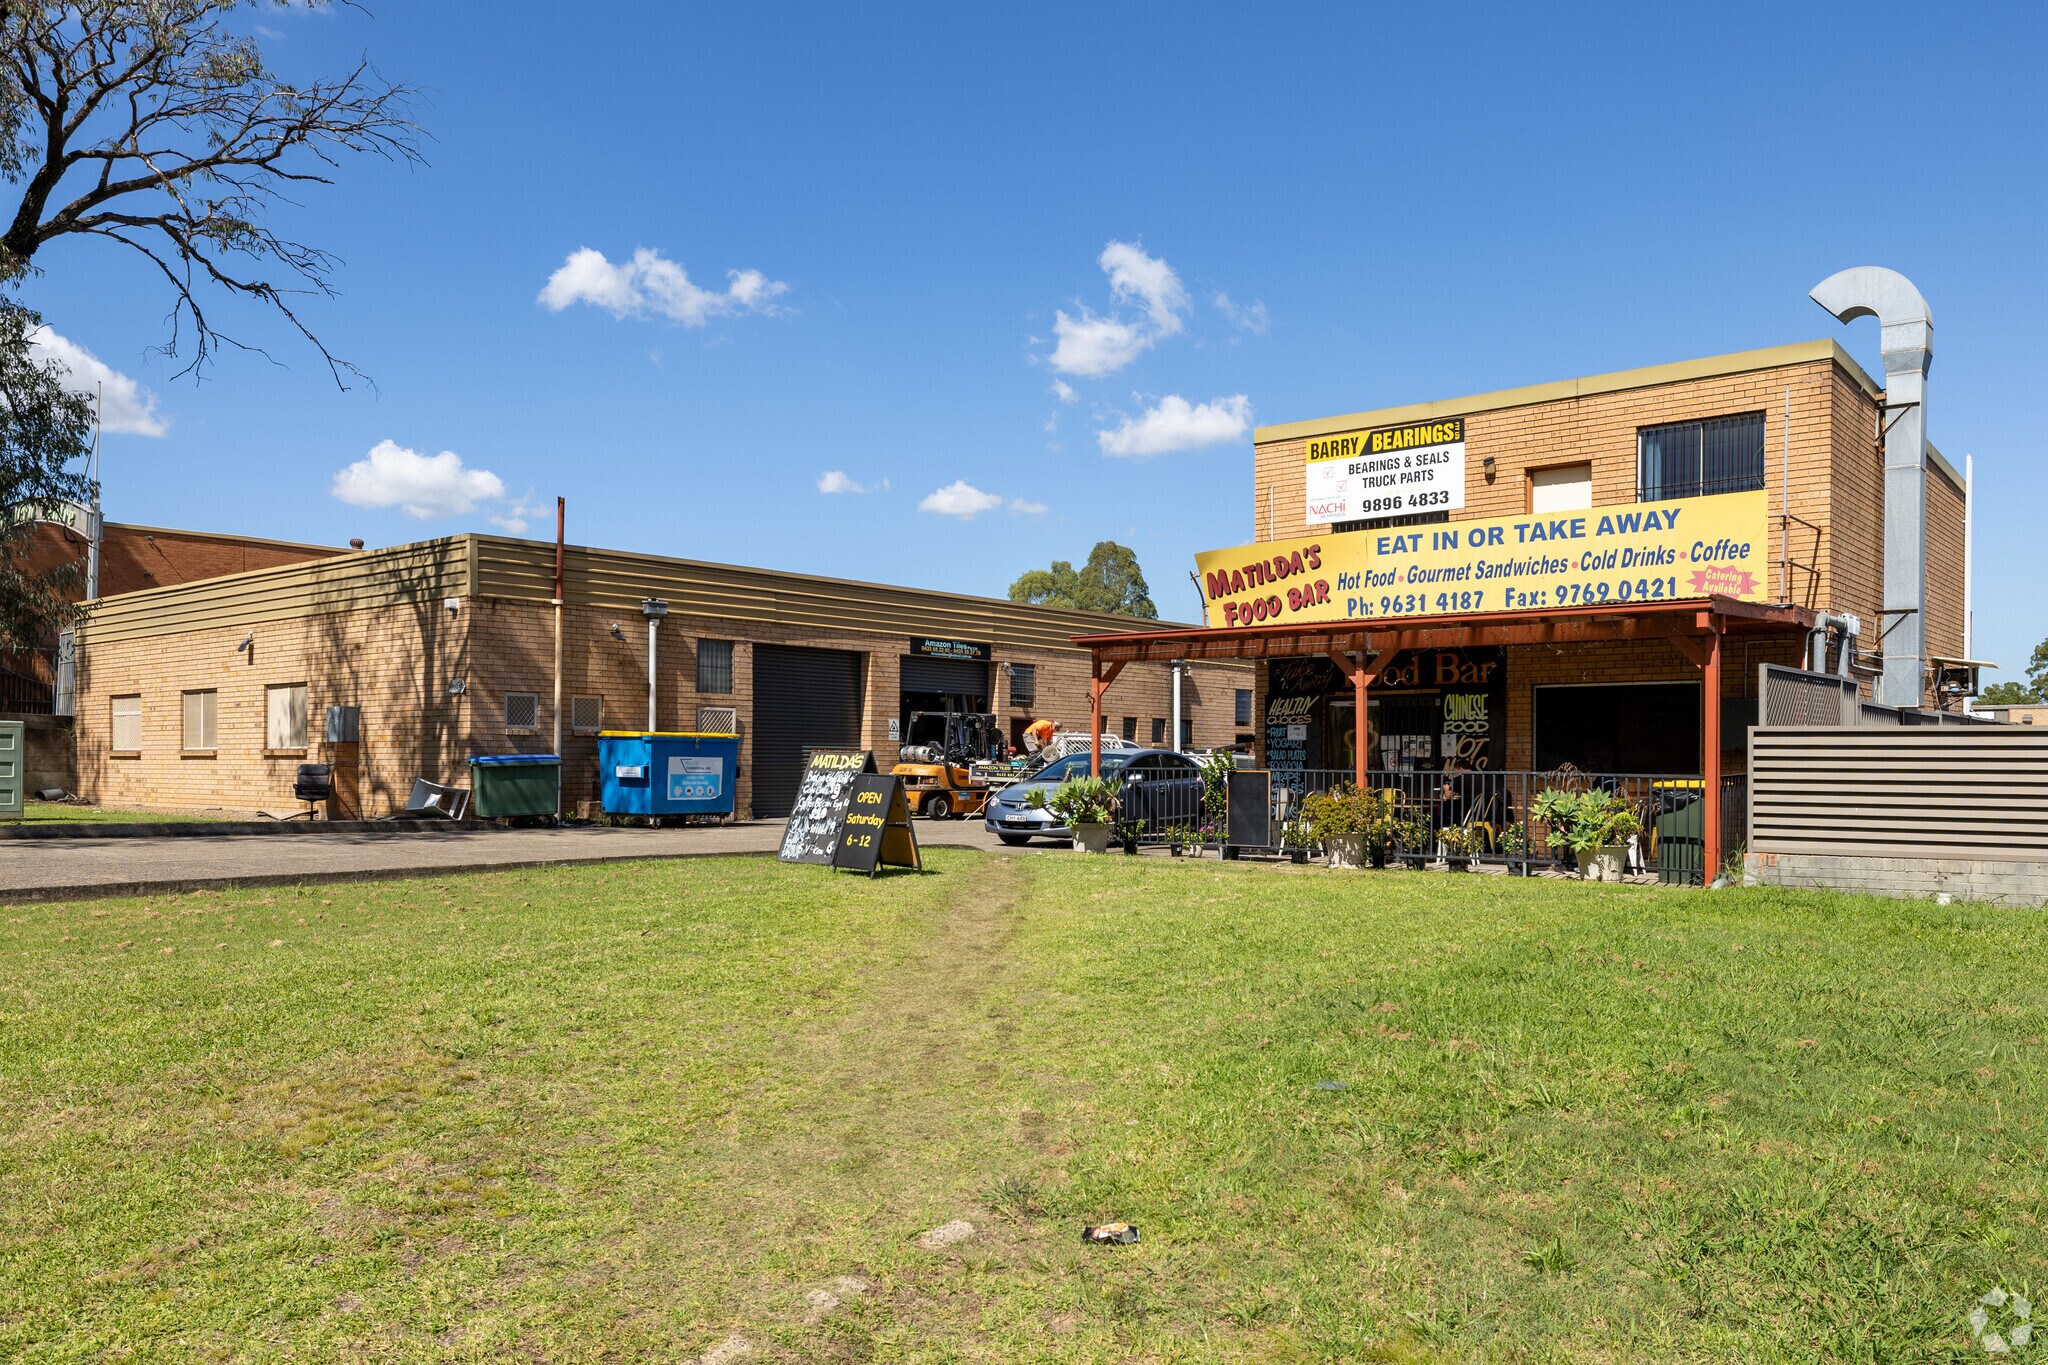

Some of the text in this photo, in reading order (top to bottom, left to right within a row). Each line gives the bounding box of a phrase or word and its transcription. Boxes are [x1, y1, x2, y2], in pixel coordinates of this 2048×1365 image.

[1311, 423, 1454, 460] BARRY BEARINGS
[1348, 451, 1450, 475] BEARINGS & SEALS
[1362, 469, 1434, 489] TRUCK PARTS
[1363, 491, 1449, 513] 9896 4833
[1377, 508, 1682, 555] EAT IN OR TAKE AWAY
[1206, 544, 1322, 600] MATILDA'S
[1337, 539, 1750, 591] Hot Food Gourmet Sandwiches Cold Drinks Coffee
[1705, 568, 1742, 585] Catering
[1347, 577, 1676, 617] Ph: 9631 4187 Fax: 9769 0421
[1702, 581, 1741, 595] Available
[1223, 579, 1331, 627] FOOD BAR
[924, 639, 951, 648] Amazon
[1433, 653, 1496, 685] Bar
[1268, 695, 1320, 716] HEALTHY
[1444, 694, 1488, 720] CHINESE
[1266, 714, 1312, 725] CHOICES
[1444, 720, 1489, 734] FOOD
[1270, 727, 1286, 738] FRUIT
[810, 753, 864, 769] MATILDA'S
[1270, 749, 1307, 761] SALAD PLATES
[857, 792, 882, 804] OPEN
[846, 813, 884, 829] Saturday
